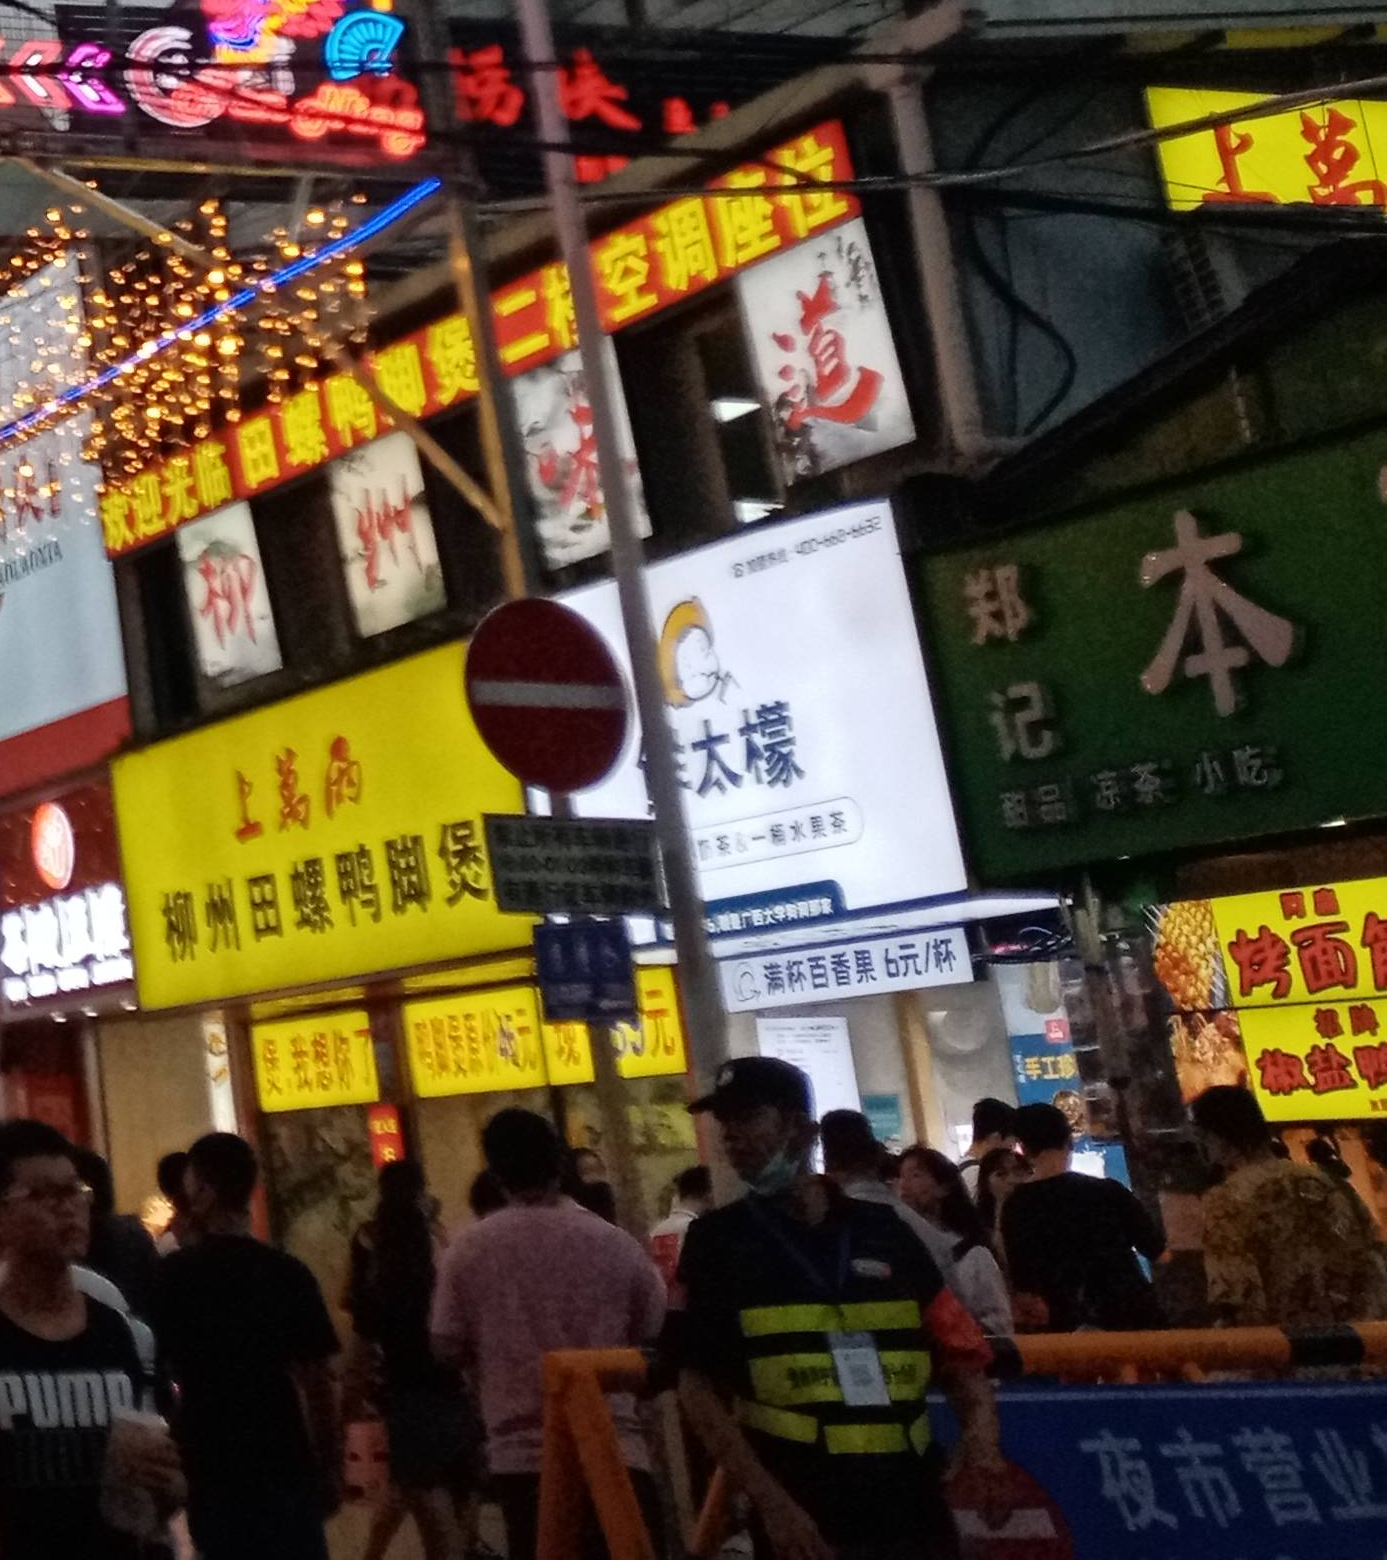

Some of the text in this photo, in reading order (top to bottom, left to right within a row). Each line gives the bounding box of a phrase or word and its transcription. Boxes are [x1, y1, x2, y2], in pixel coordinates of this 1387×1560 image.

[101, 440, 233, 551] 欢迎光临
[161, 819, 493, 963] 柳州田螺鸭脚煲
